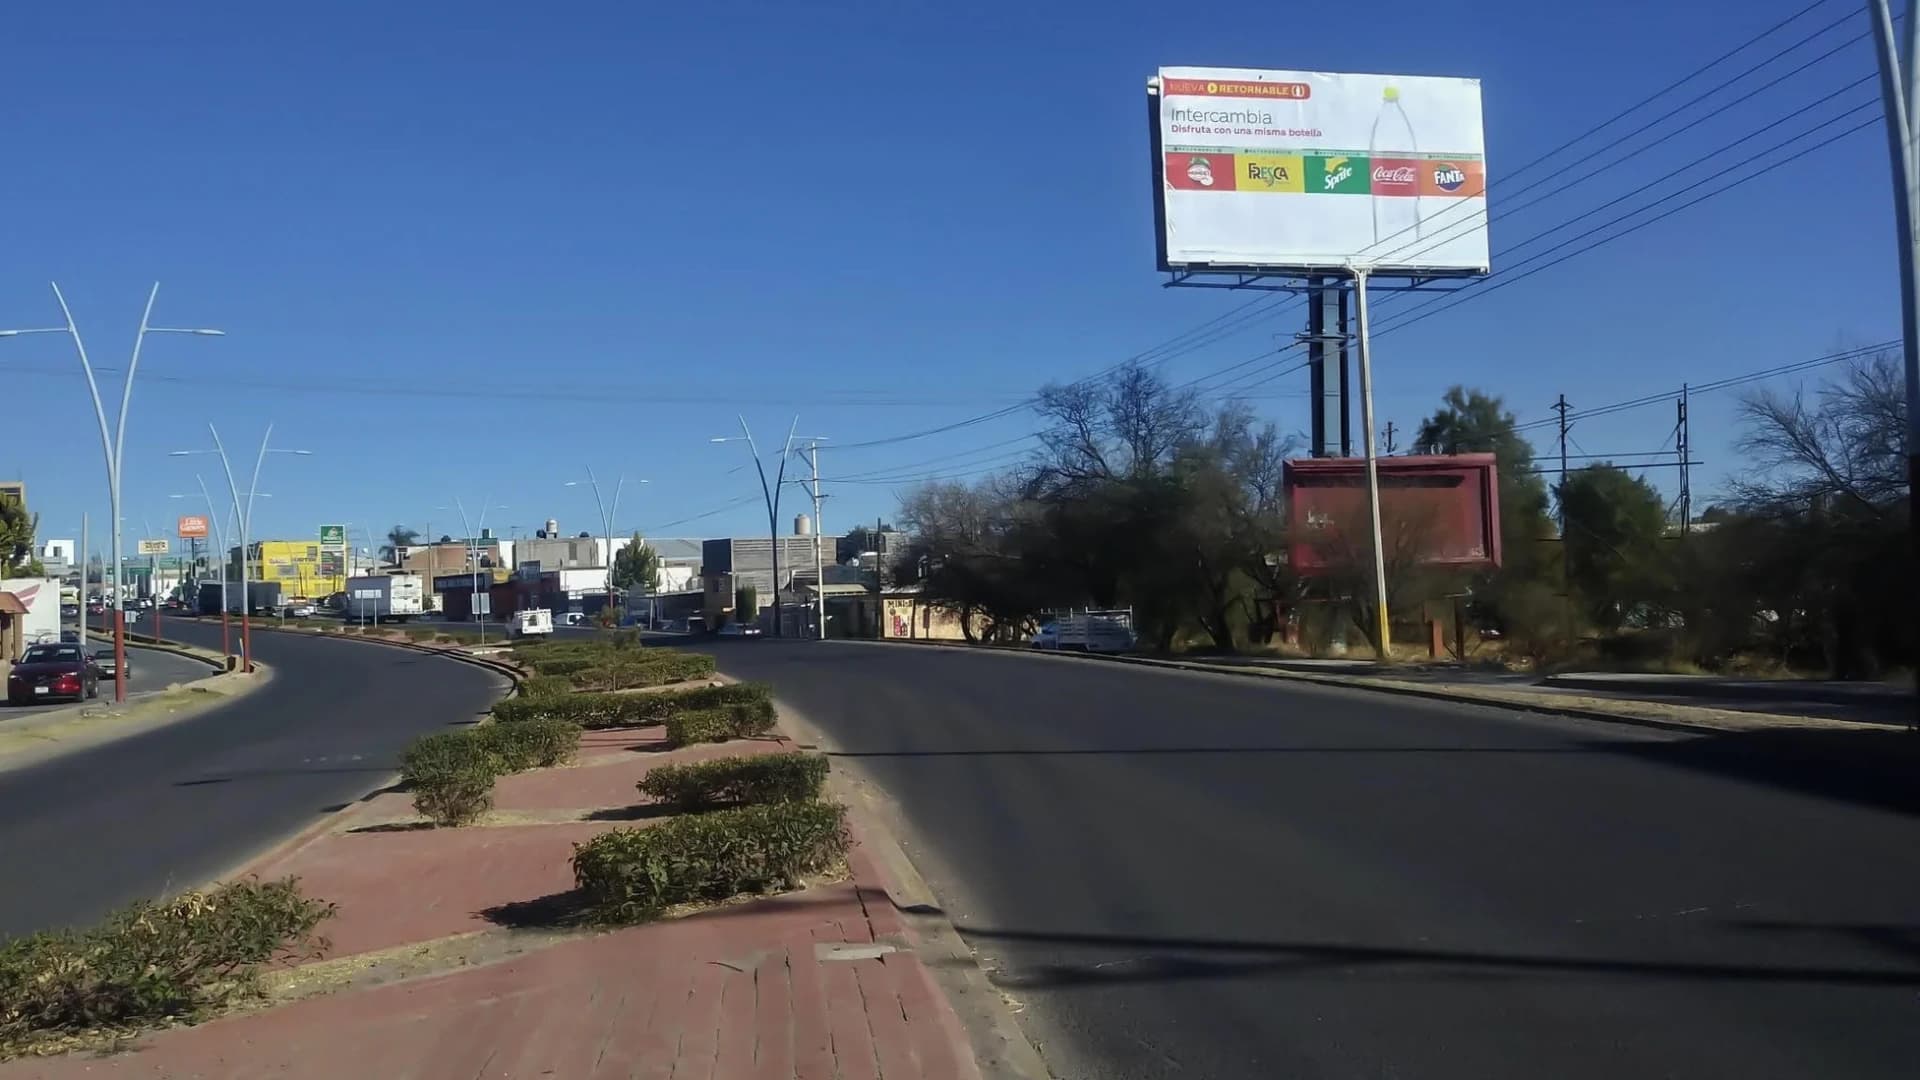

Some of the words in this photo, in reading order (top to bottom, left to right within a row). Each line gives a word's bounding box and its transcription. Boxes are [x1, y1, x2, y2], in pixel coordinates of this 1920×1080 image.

[1169, 83, 1204, 95] NUEVA
[1219, 84, 1289, 96] RETORNABLE
[1171, 108, 1272, 125] Intercambia
[1171, 125, 1211, 134] Disfruta
[1234, 128, 1252, 136] una
[1254, 129, 1287, 137] misma
[1289, 129, 1322, 138] botella
[1248, 162, 1289, 187] FRESCA
[1324, 166, 1353, 190] Sprite
